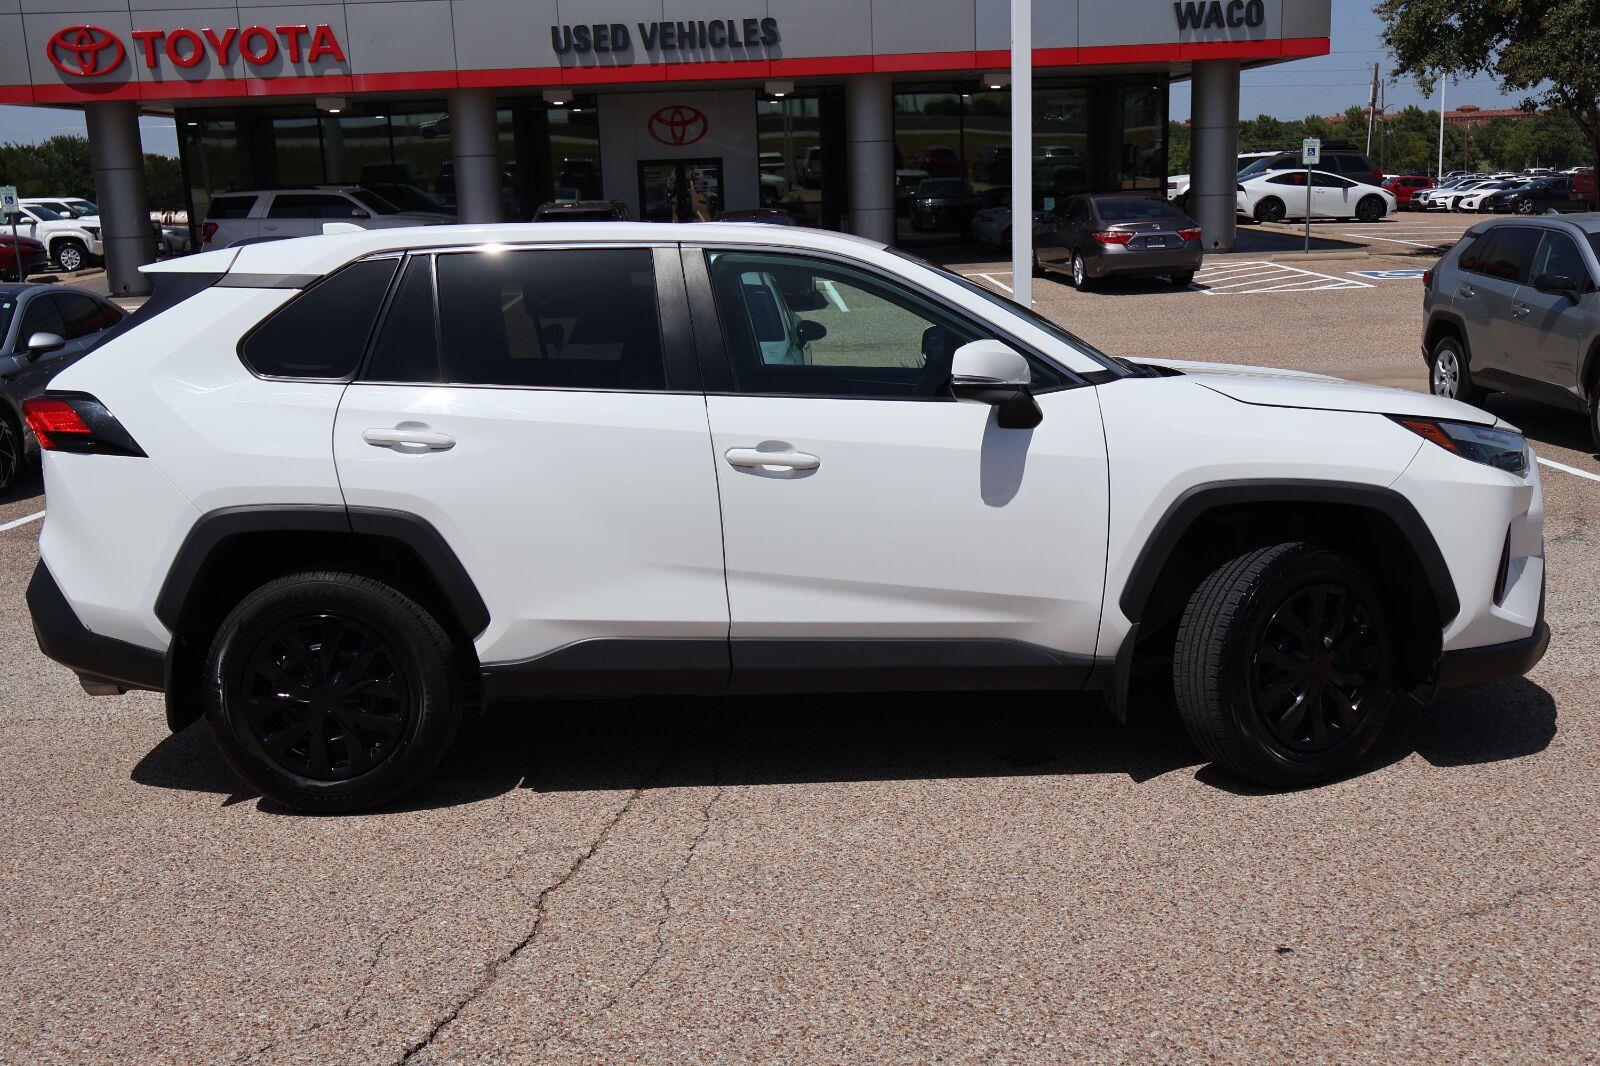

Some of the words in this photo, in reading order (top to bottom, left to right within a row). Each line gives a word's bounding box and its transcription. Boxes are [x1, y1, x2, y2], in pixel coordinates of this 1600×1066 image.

[1174, 0, 1265, 29] WACO
[131, 24, 346, 68] TOYOTA
[551, 23, 629, 54] USED
[638, 17, 779, 51] VEHICLES
